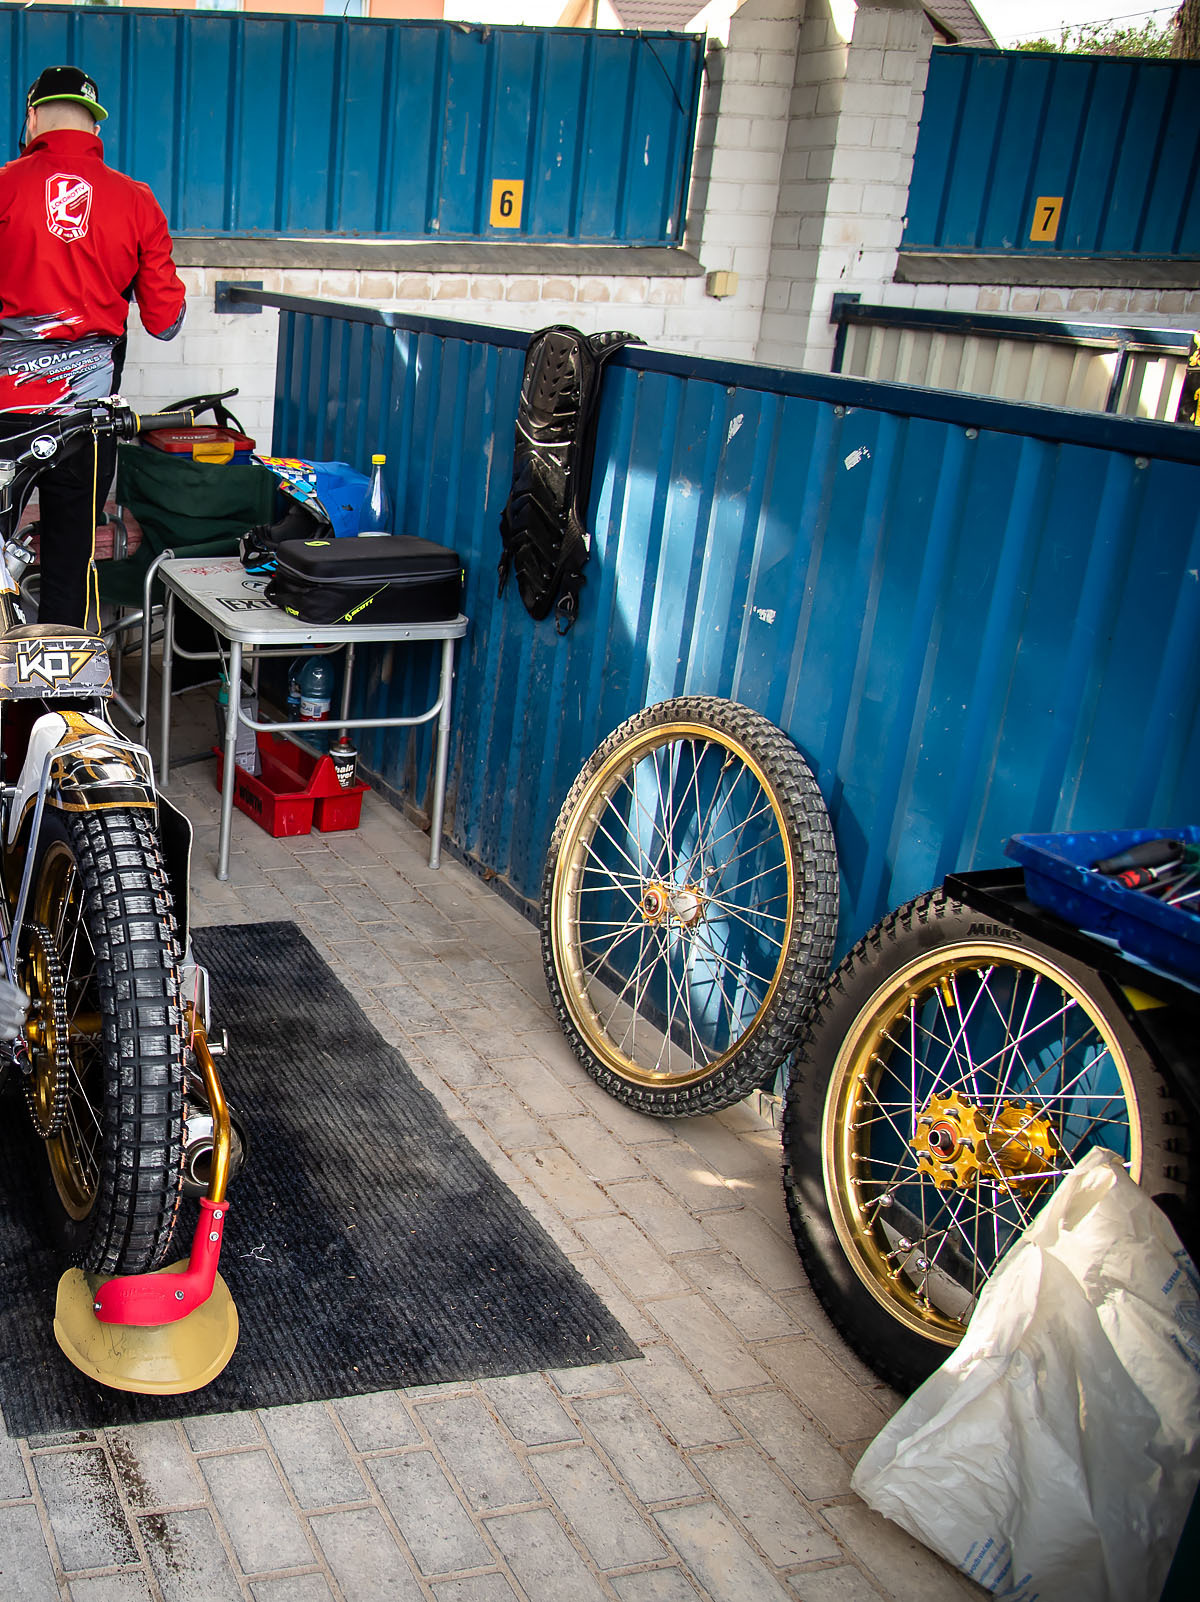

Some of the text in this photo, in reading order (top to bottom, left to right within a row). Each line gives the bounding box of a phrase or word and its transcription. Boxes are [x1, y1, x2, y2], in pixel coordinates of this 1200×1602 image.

[500, 190, 514, 217] 6
[1042, 206, 1056, 231] 7
[967, 922, 1023, 942] Mitas
